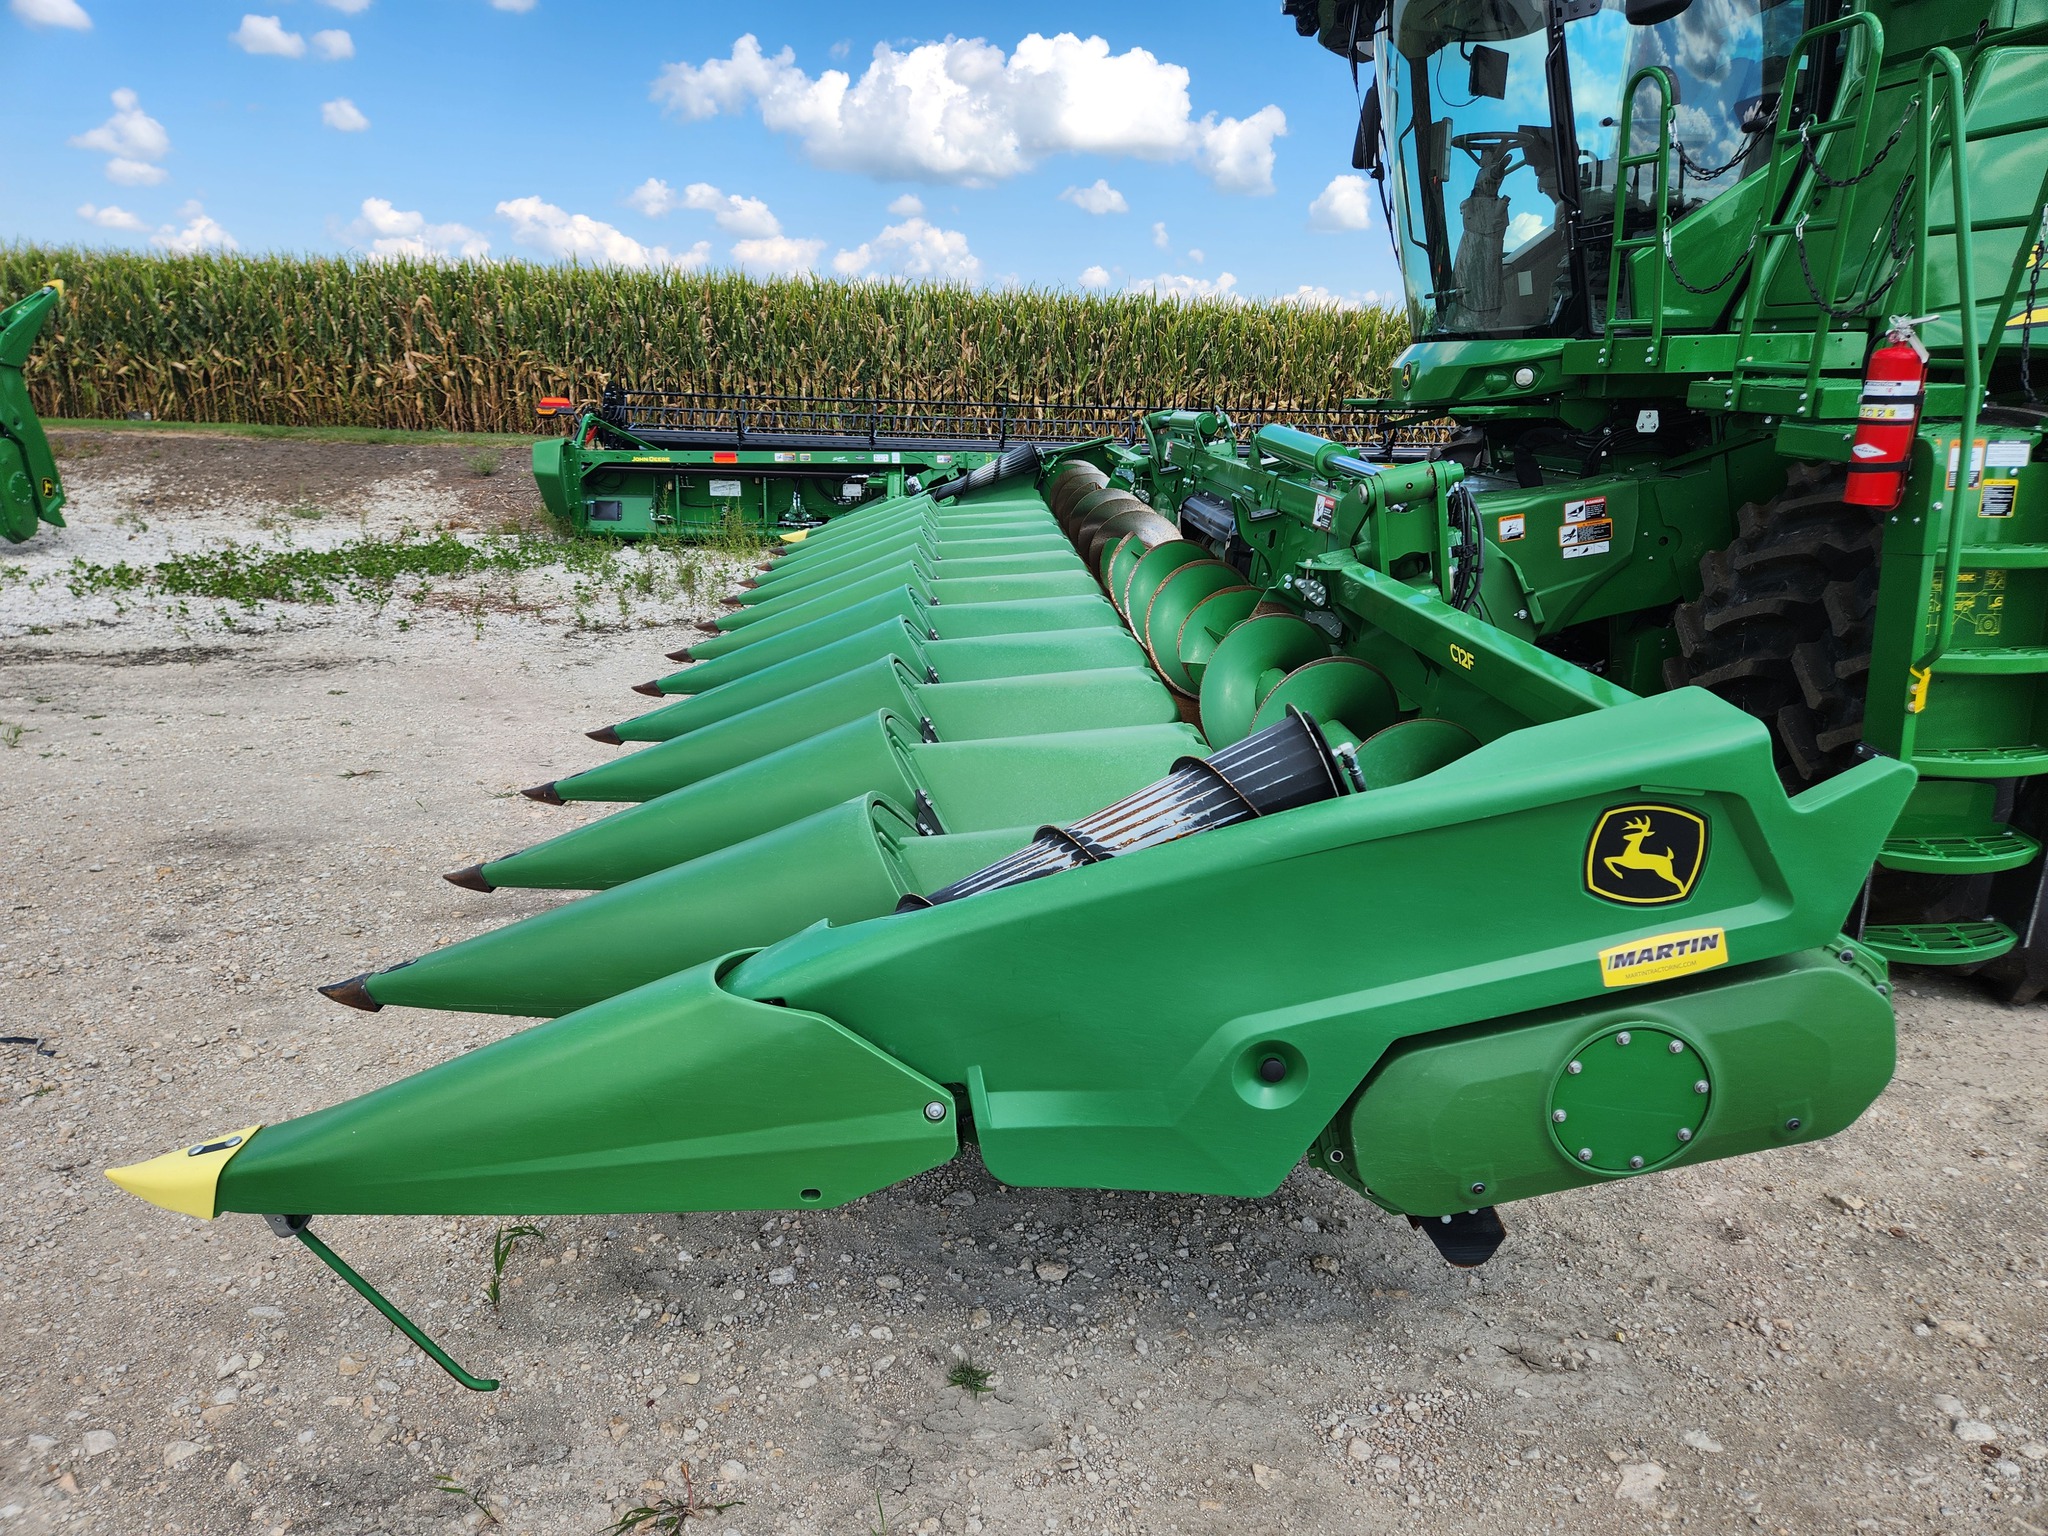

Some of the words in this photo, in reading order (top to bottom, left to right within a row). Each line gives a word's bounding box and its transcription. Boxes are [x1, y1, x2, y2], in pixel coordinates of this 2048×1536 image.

[1450, 643, 1475, 671] C12F
[1613, 934, 1719, 969] MARTIN
[1625, 960, 1697, 979] MARTINTRACTORINC.COM
